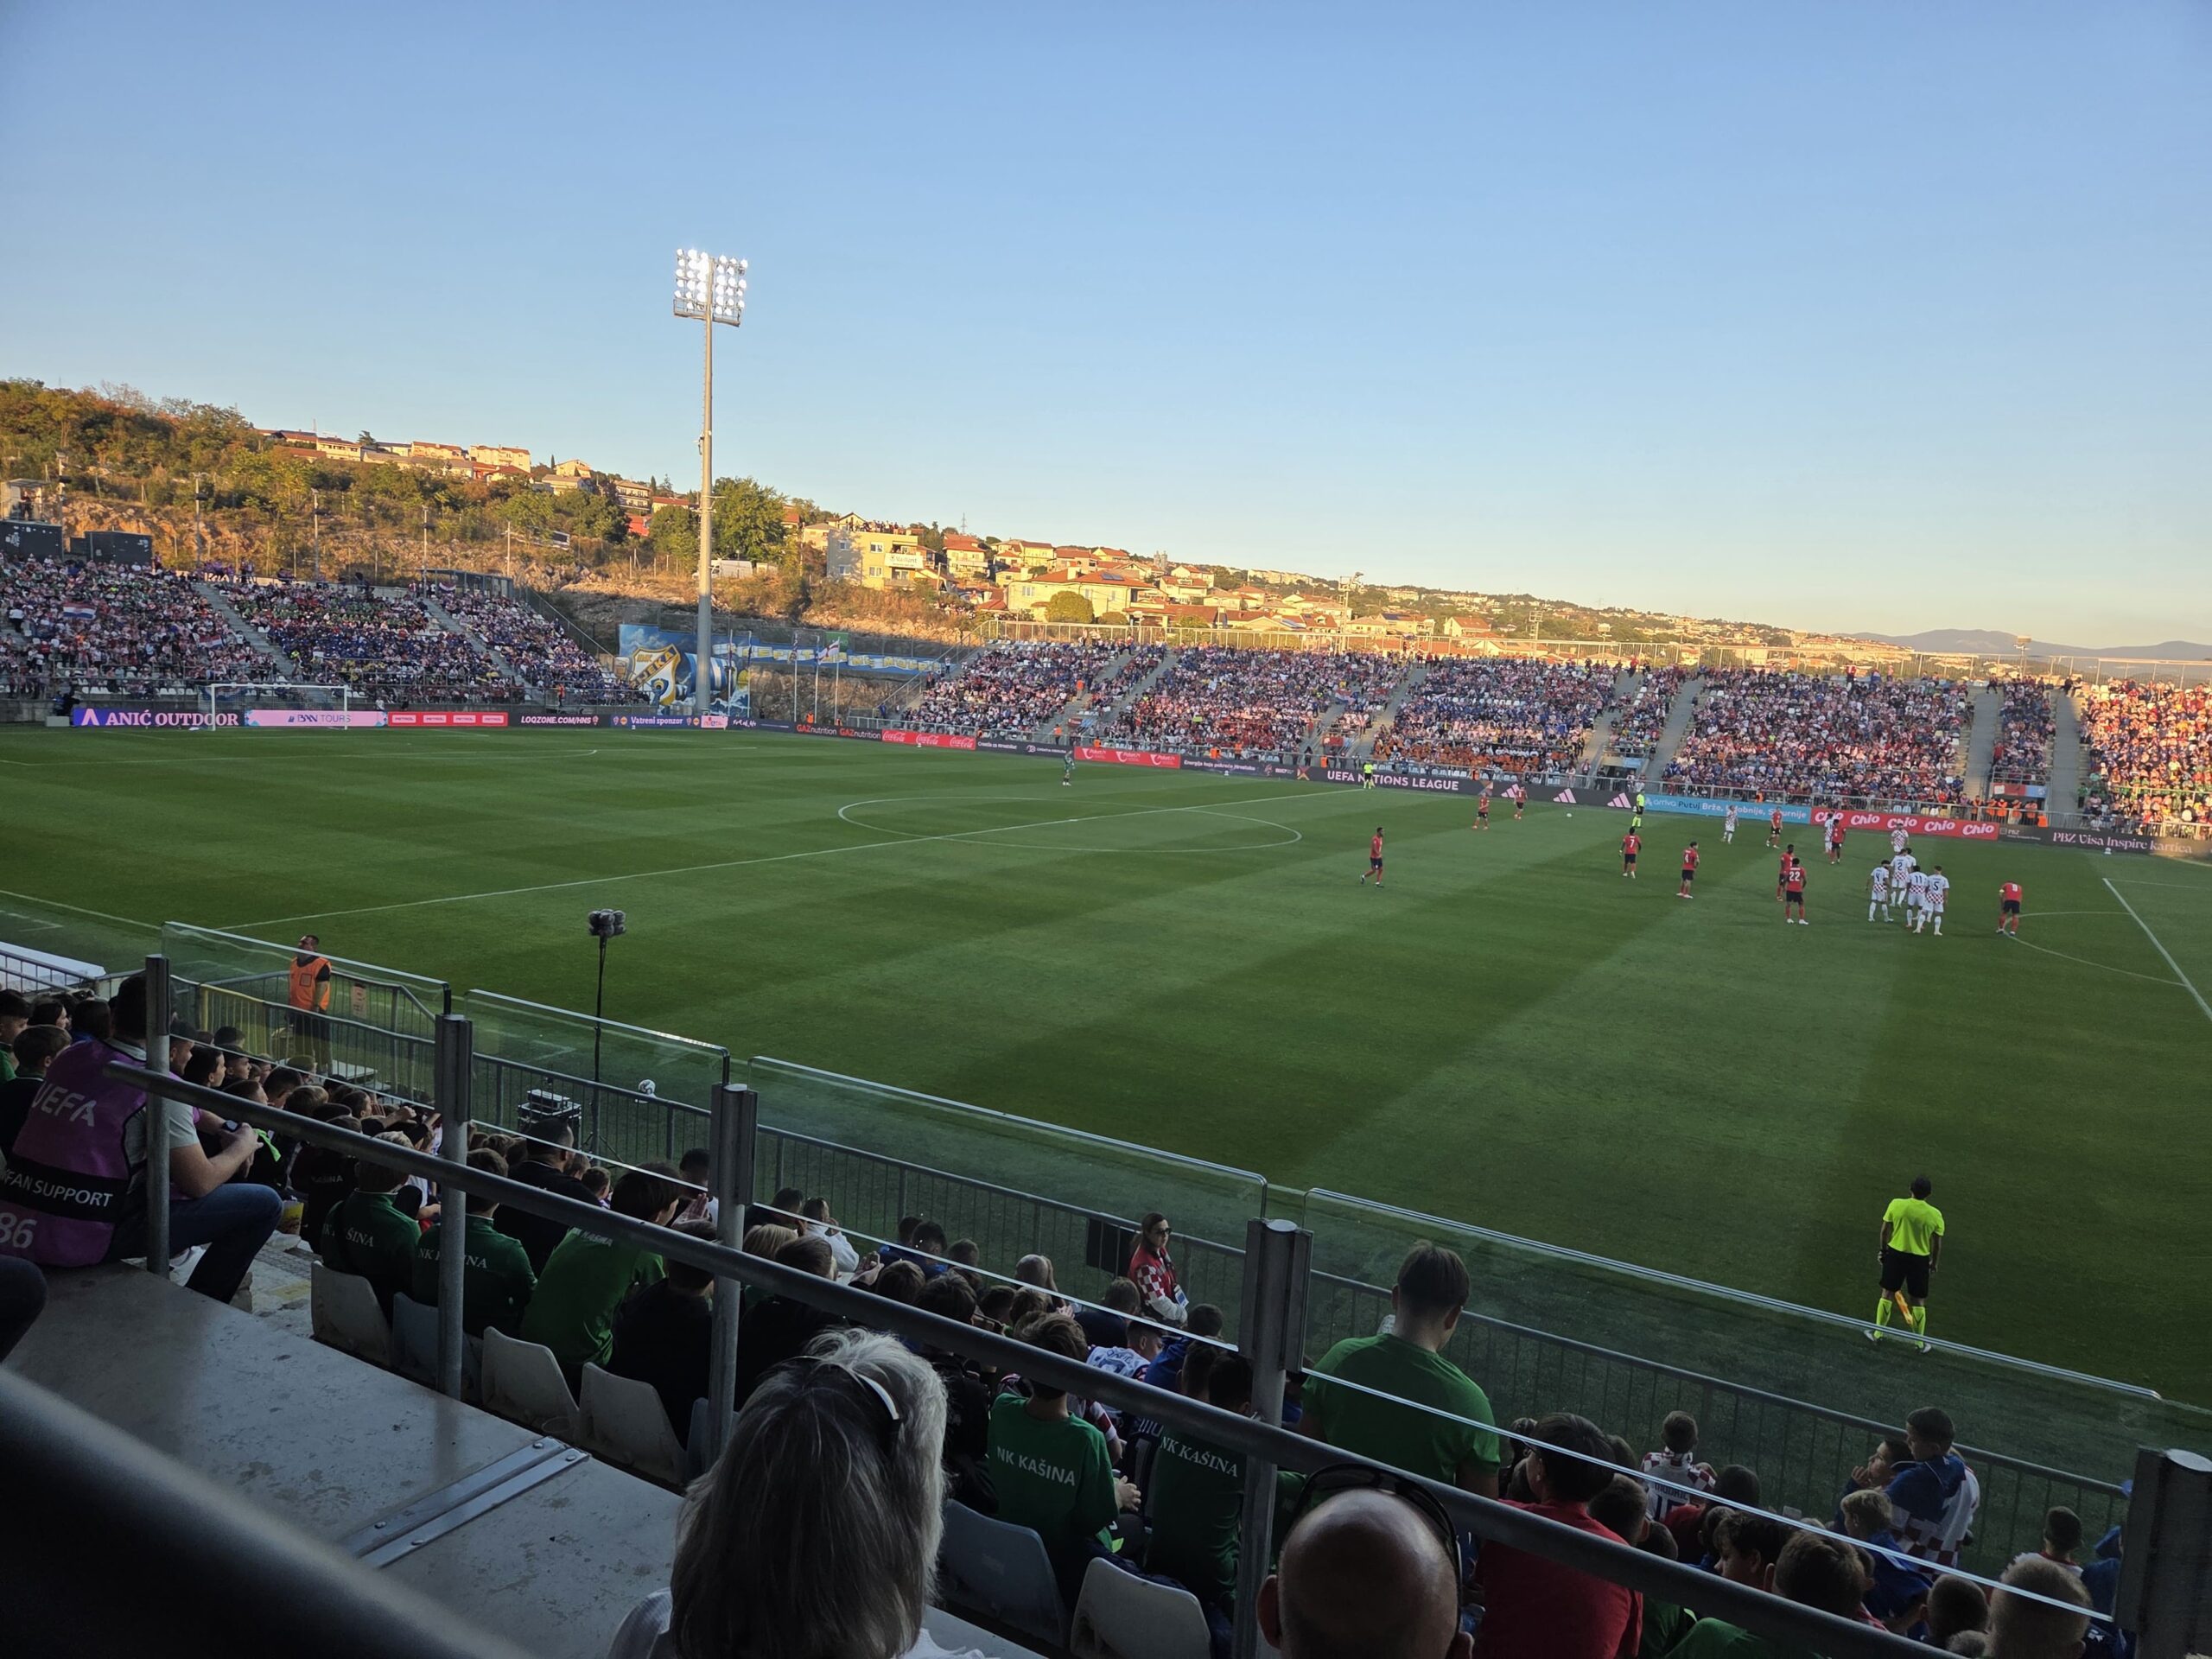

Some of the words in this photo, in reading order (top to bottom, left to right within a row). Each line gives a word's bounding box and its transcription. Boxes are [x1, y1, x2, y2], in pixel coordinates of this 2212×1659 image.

[105, 709, 152, 726] ANIĆ
[155, 713, 238, 726] OUTDOOR
[1327, 770, 1354, 782] UEFA
[1357, 774, 1408, 787] NTIONS
[1412, 779, 1459, 791] LEAGUE
[1678, 800, 1700, 810] Putuj
[1850, 814, 1880, 826] Chio
[1924, 820, 1955, 832] Chio
[1962, 823, 1995, 836] Chio
[2052, 832, 2076, 843] PBZ
[2107, 836, 2148, 850] Inspire
[2150, 841, 2192, 854] kartica
[1897, 861, 1903, 871] 2
[1789, 871, 1801, 882] 22
[1915, 875, 1923, 884] 11
[1933, 881, 1939, 891] 5
[31, 1083, 97, 1128] UEFA
[32, 1179, 114, 1208] SUPPORT
[1160, 1435, 1179, 1454] NK
[1178, 1444, 1238, 1478] KAŠINA
[996, 1445, 1015, 1465] NK
[1018, 1454, 1076, 1487] KAŠINA
